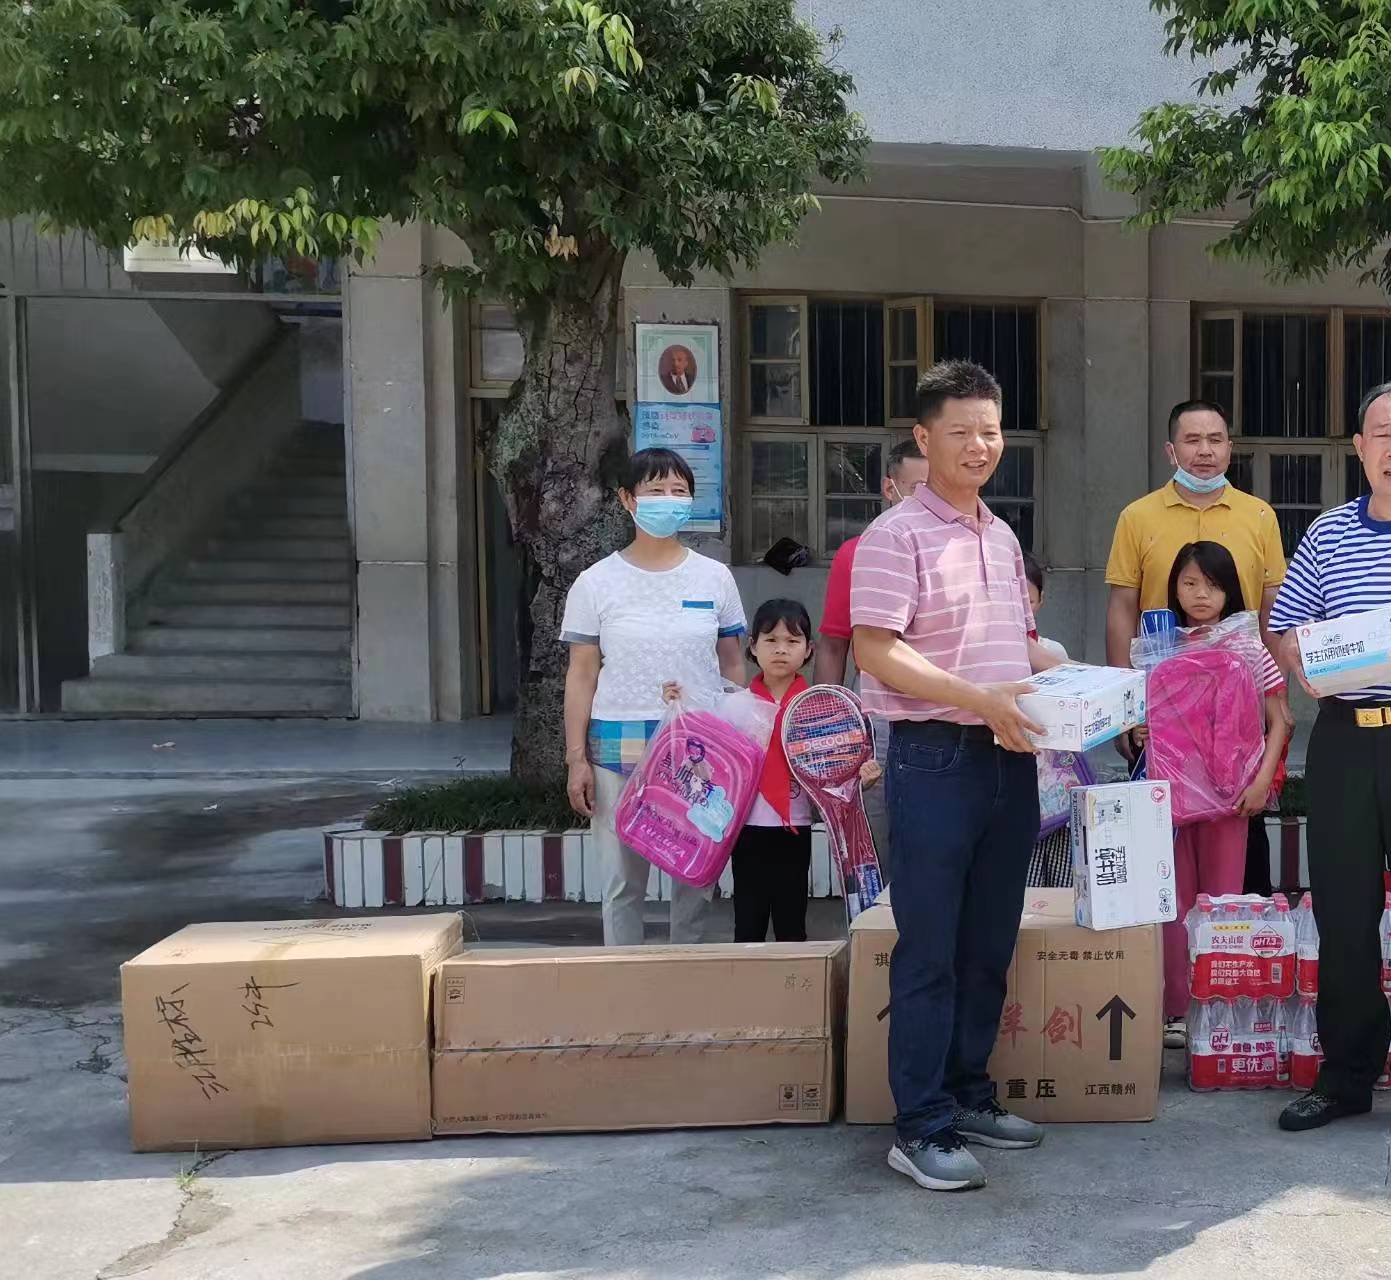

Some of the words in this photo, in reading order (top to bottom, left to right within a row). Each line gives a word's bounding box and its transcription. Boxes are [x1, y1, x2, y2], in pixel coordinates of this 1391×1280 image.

[1036, 950, 1079, 961] 安全无毒
[1083, 950, 1125, 961] 禁止饮用
[1231, 1057, 1275, 1073] 更优惠
[1084, 1082, 1136, 1096] 江西赣州
